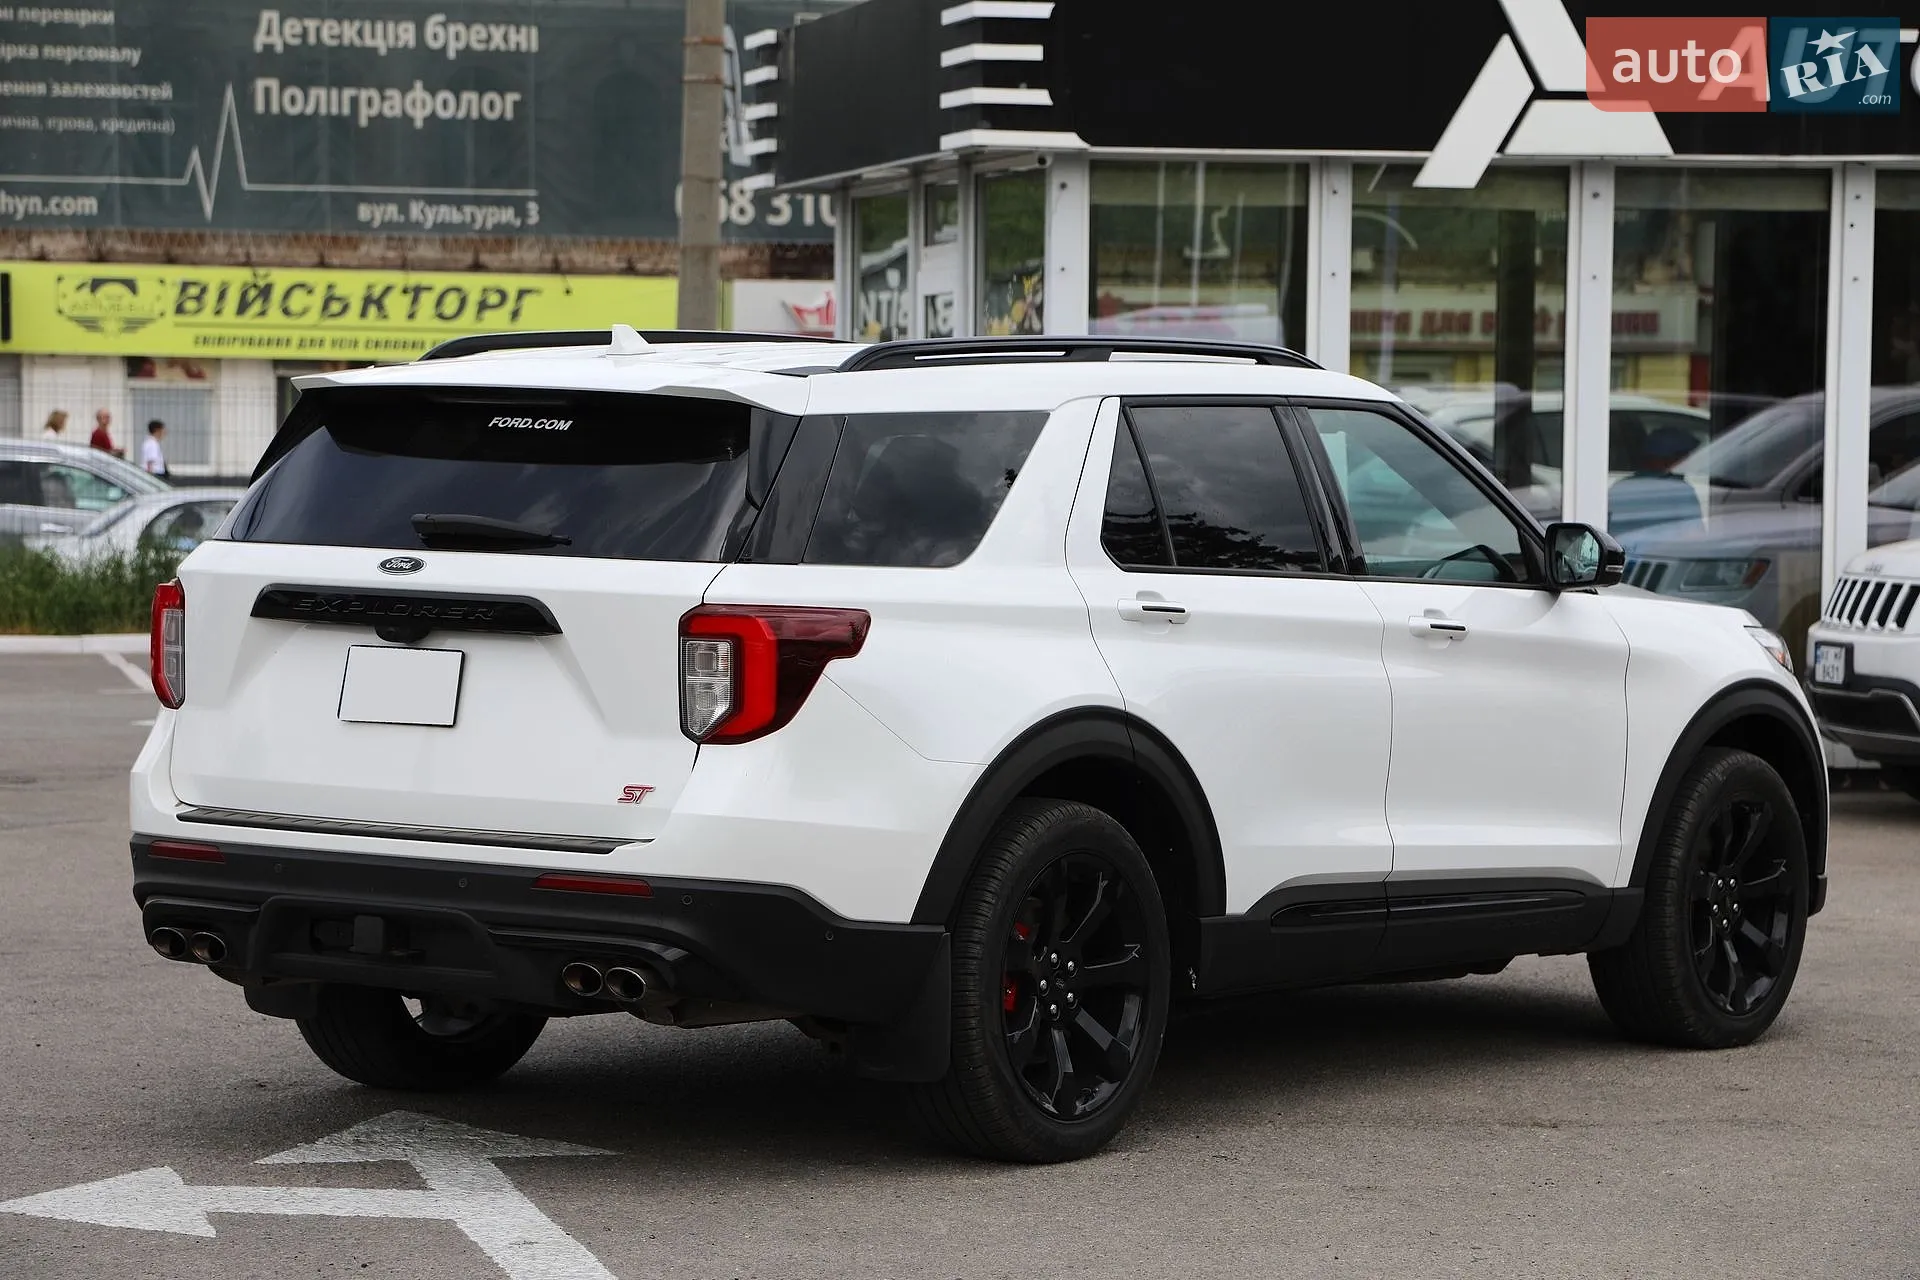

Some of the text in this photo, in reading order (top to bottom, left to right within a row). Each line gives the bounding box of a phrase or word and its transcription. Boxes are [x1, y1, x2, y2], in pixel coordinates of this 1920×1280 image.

[17, 6, 116, 29] перевірки
[254, 8, 540, 61] Детекція брехні
[42, 42, 142, 68] персоналу
[1697, 25, 1920, 103] AUT
[51, 80, 173, 101] залежностей
[254, 76, 523, 130] Поліграфолог
[0, 188, 99, 221] hyn.com
[357, 198, 541, 231] вул. Культури, 3
[173, 268, 543, 325] ВІЙСЬКТОРГ
[488, 416, 574, 431] FORD.COM
[292, 599, 496, 621] EXPLORER
[617, 784, 656, 804] ST
